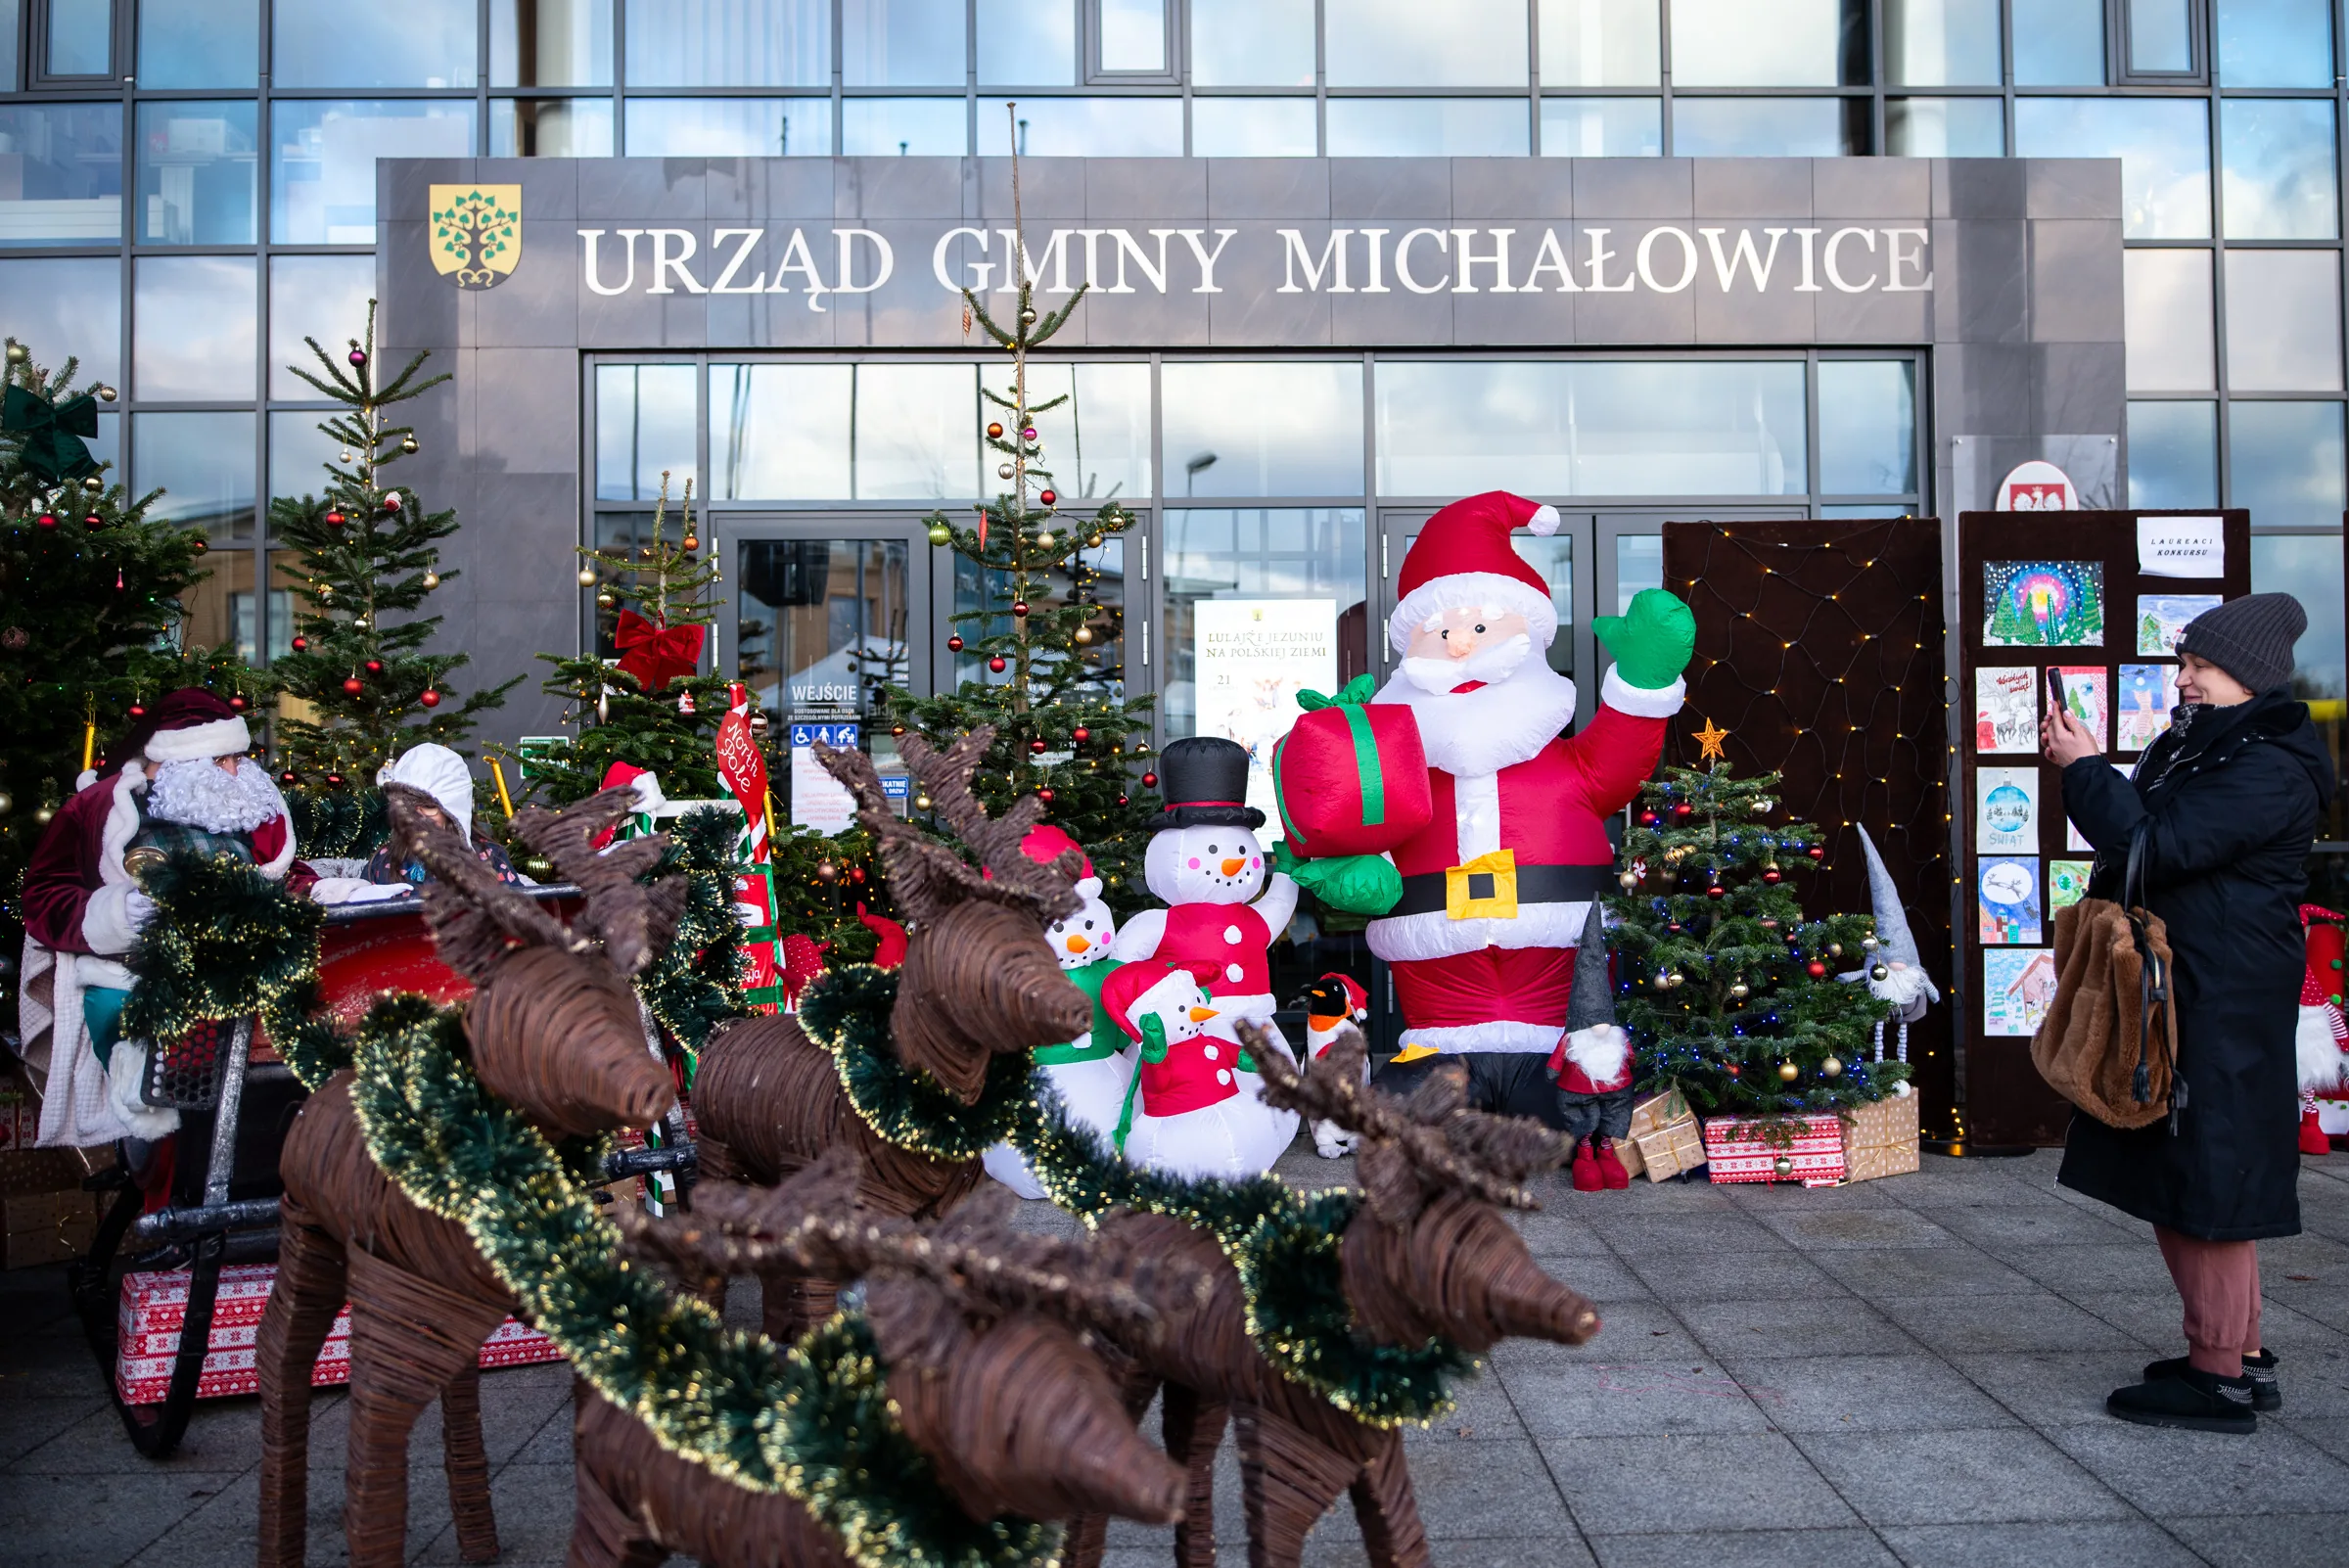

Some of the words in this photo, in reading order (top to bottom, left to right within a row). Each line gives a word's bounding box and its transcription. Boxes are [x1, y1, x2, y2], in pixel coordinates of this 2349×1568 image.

[577, 227, 894, 313] URZĄD
[933, 226, 1238, 295] GMINY
[1276, 224, 1934, 295] MICHAŁOWICE
[1267, 632, 1323, 647] JEZUNIU
[1206, 648, 1225, 658] NA
[1230, 647, 1286, 660] POLSKIEJ
[1290, 647, 1326, 657] ZIEMI
[1218, 674, 1230, 685] 21
[792, 681, 857, 701] WEJŚCIE
[727, 722, 759, 777] North
[718, 738, 751, 793] Pole
